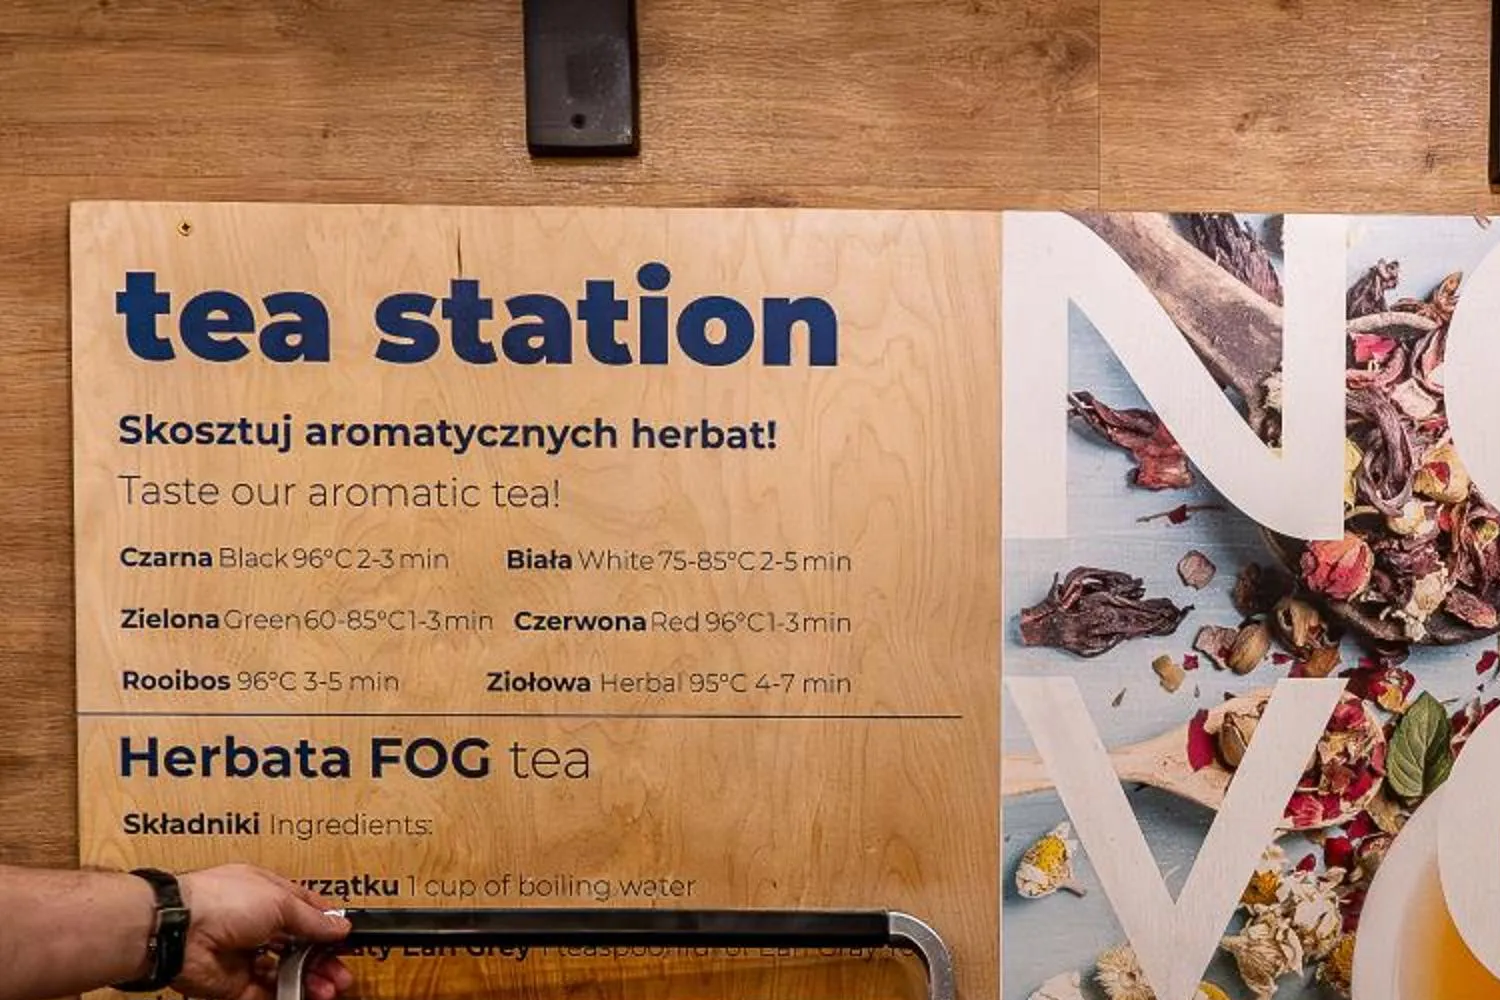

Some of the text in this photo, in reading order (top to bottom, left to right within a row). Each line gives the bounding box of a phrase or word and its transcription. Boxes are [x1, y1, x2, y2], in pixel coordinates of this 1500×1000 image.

[115, 261, 839, 368] tea station
[119, 413, 777, 456] Skosztuj aromatycznych herbat!
[117, 475, 559, 509] Taste our aromatic tea!
[120, 547, 213, 568] Czarna
[219, 546, 289, 569] Black
[357, 548, 395, 569] 2-3
[399, 547, 449, 569] min
[507, 547, 573, 570] Biała
[577, 549, 655, 571] White
[759, 551, 799, 572] 2-5
[802, 549, 852, 572] min
[121, 607, 220, 629] Zielona
[223, 609, 301, 630] Green
[407, 609, 441, 631] 1-3
[444, 609, 494, 632] min
[514, 611, 647, 632] Czerwona
[651, 610, 700, 633] Red
[767, 611, 800, 633] 1-3
[801, 610, 852, 634] min
[123, 668, 231, 691] Rooibos
[303, 671, 343, 692] 3-5
[348, 671, 400, 693] min
[486, 670, 591, 693] Ziołowa
[600, 671, 682, 693] Herbal
[754, 673, 796, 693] 4-7
[802, 672, 852, 695] min
[120, 735, 589, 779] Herbata FOG tea
[123, 811, 433, 841] Składniki Ingredients:
[424, 879, 477, 901] cup
[484, 873, 512, 897] of
[519, 872, 611, 903] boiling
[619, 878, 697, 897] water
